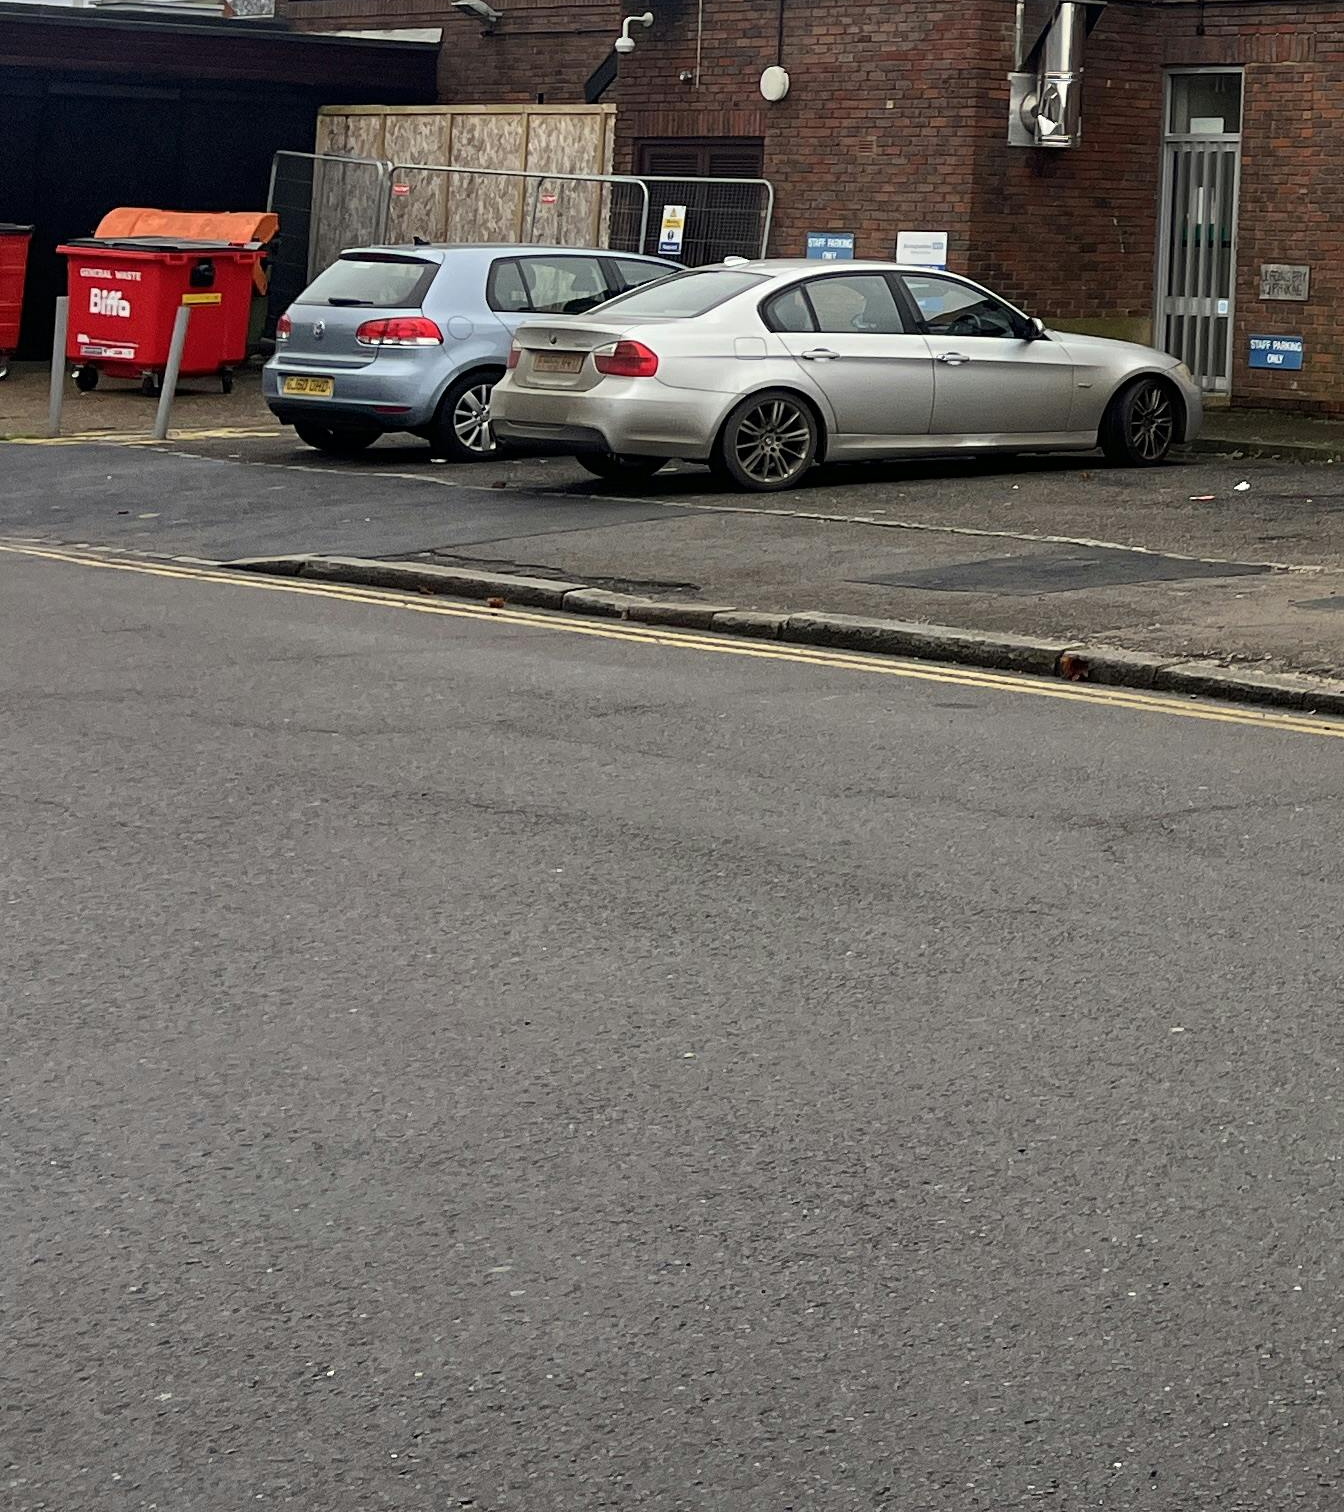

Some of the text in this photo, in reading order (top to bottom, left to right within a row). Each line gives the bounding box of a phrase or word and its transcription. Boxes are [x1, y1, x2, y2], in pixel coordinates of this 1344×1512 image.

[808, 239, 827, 248] STAFF
[115, 270, 141, 281] WASTE
[89, 288, 130, 318] Biffa
[1250, 339, 1302, 351] STAFF PARKING
[1267, 354, 1284, 364] ONLY
